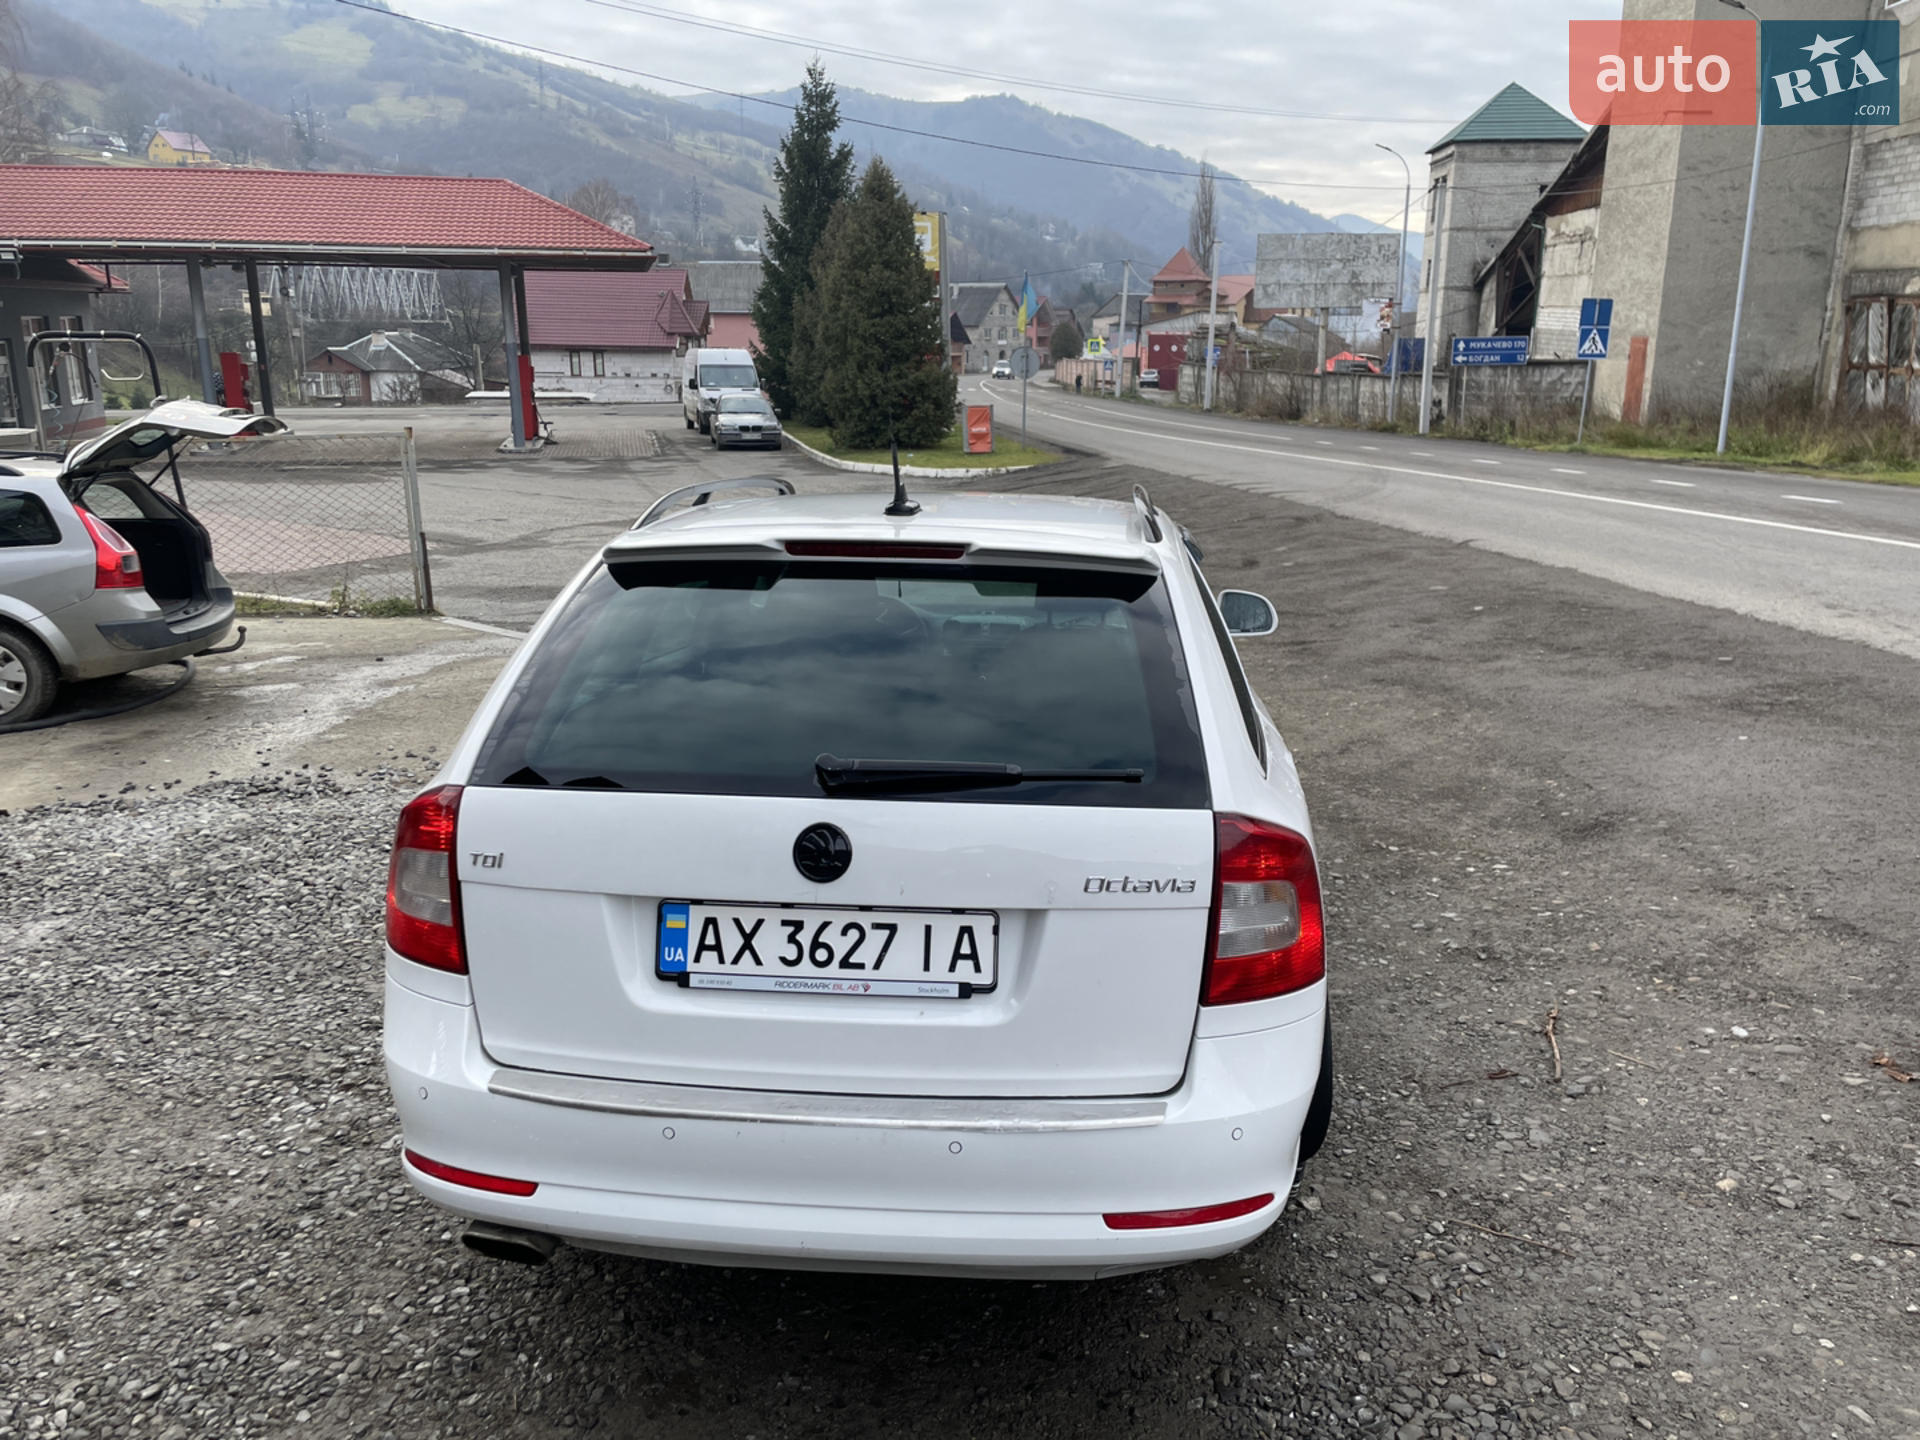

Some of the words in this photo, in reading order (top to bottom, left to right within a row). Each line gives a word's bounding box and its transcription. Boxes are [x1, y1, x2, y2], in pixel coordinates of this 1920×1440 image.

[1469, 341, 1513, 349] МУКАЧЕВО
[1514, 341, 1526, 349] 170
[1468, 354, 1501, 363] БОГДАН
[1083, 876, 1197, 893] Octavia
[693, 917, 766, 967] AX
[778, 919, 899, 971] 3627
[923, 924, 982, 974] IA
[664, 946, 685, 962] UA
[774, 980, 831, 990] RIDDERMARK
[832, 983, 845, 991] BIL
[847, 983, 860, 991] AB
[917, 986, 950, 994] Stockholm
